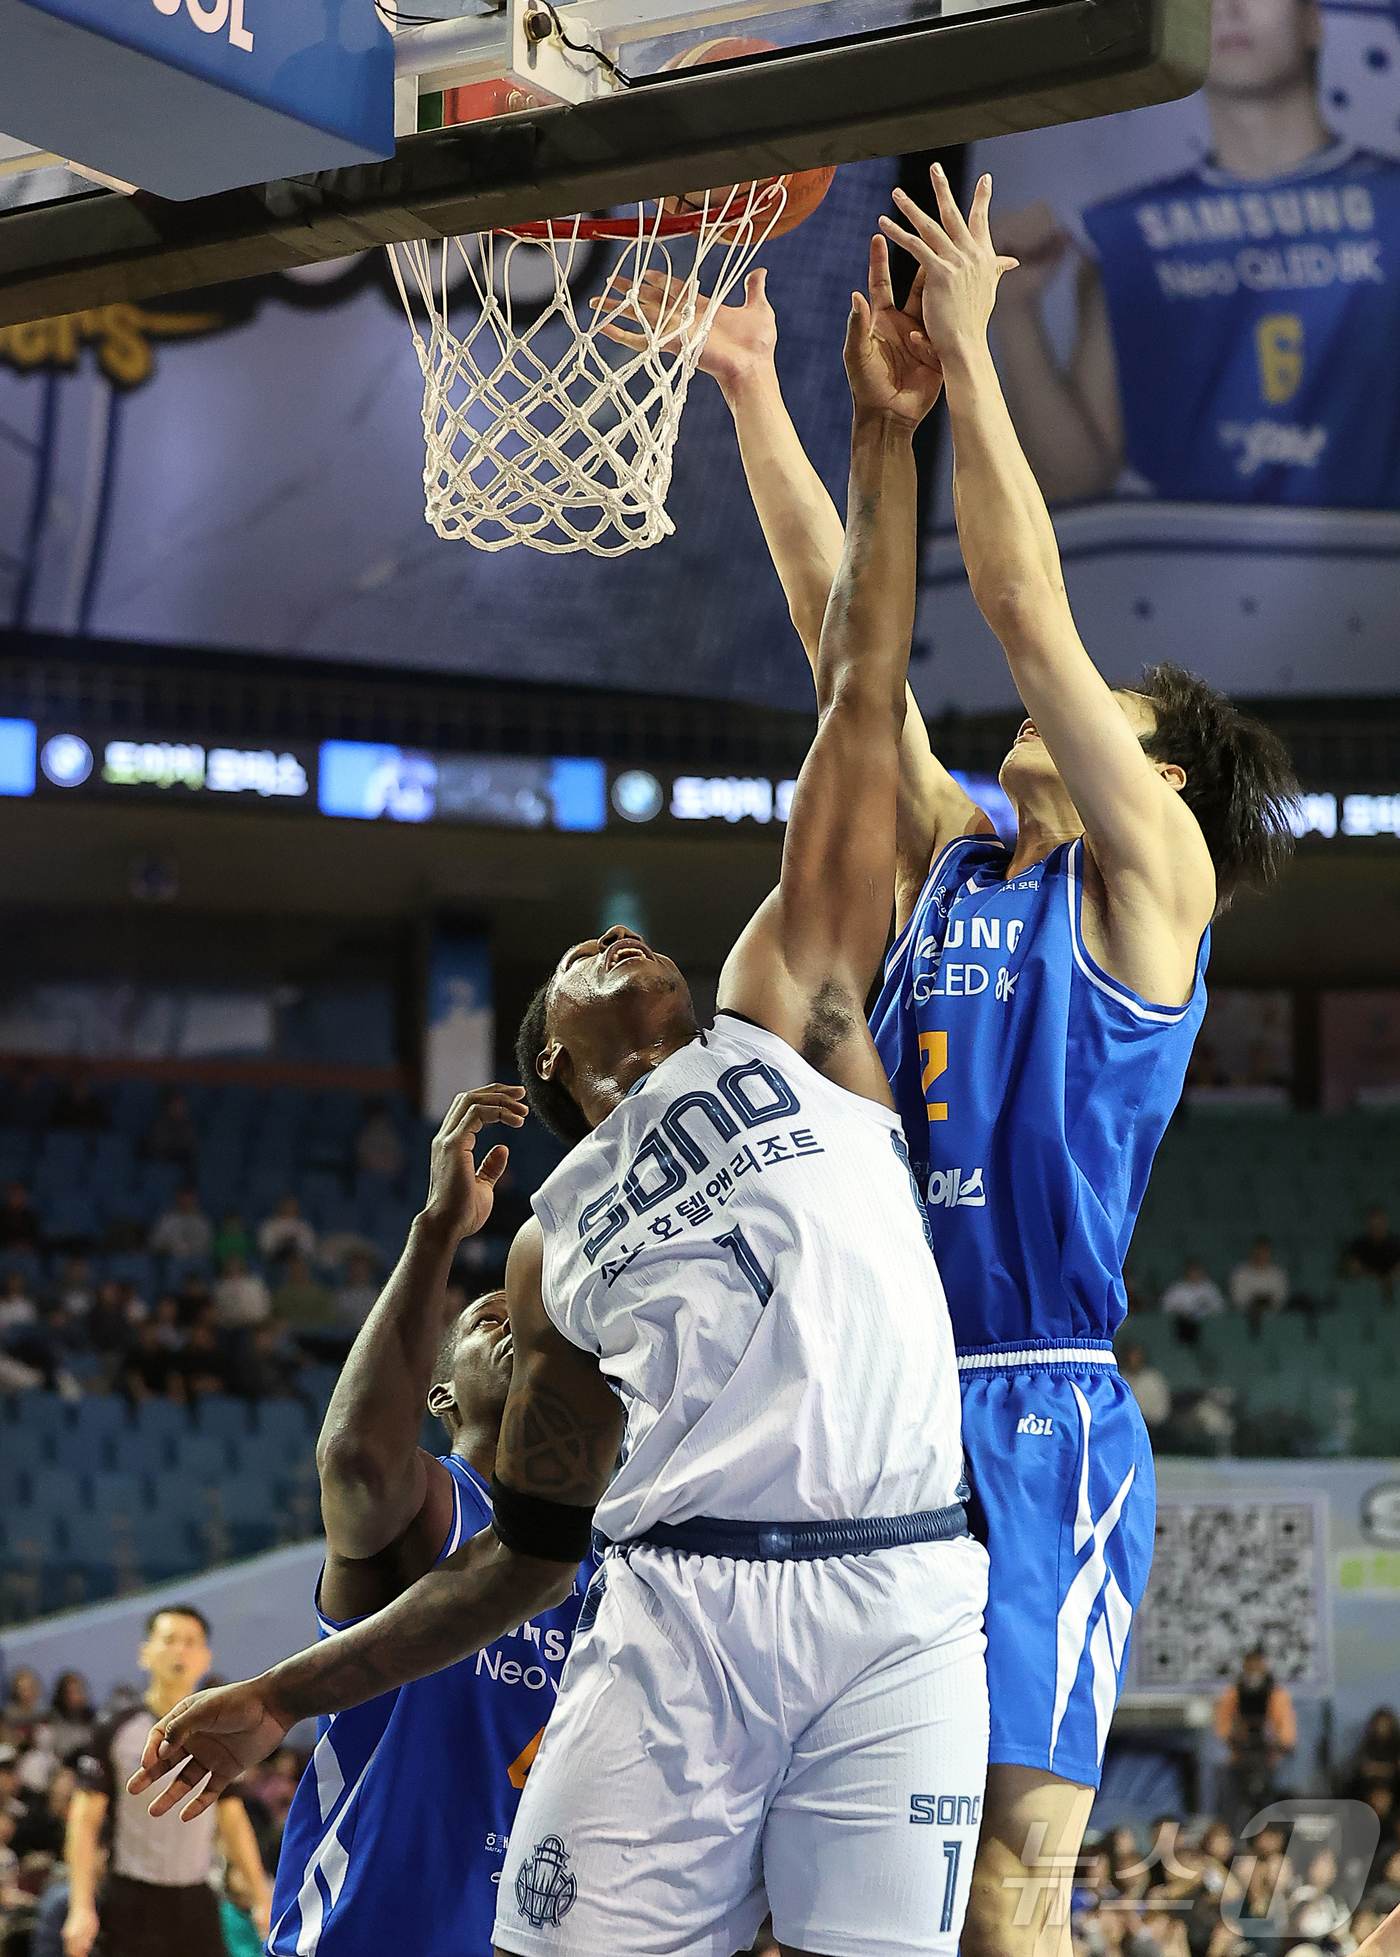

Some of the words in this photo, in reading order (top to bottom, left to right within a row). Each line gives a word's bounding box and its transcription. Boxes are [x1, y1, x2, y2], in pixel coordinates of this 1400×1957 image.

[1255, 312, 1304, 406] 6
[926, 1168, 986, 1208] 예스
[712, 1223, 774, 1308] 1
[1016, 1412, 1053, 1436] KBL
[475, 1647, 547, 1690] Neo
[939, 1840, 963, 1933] 1
